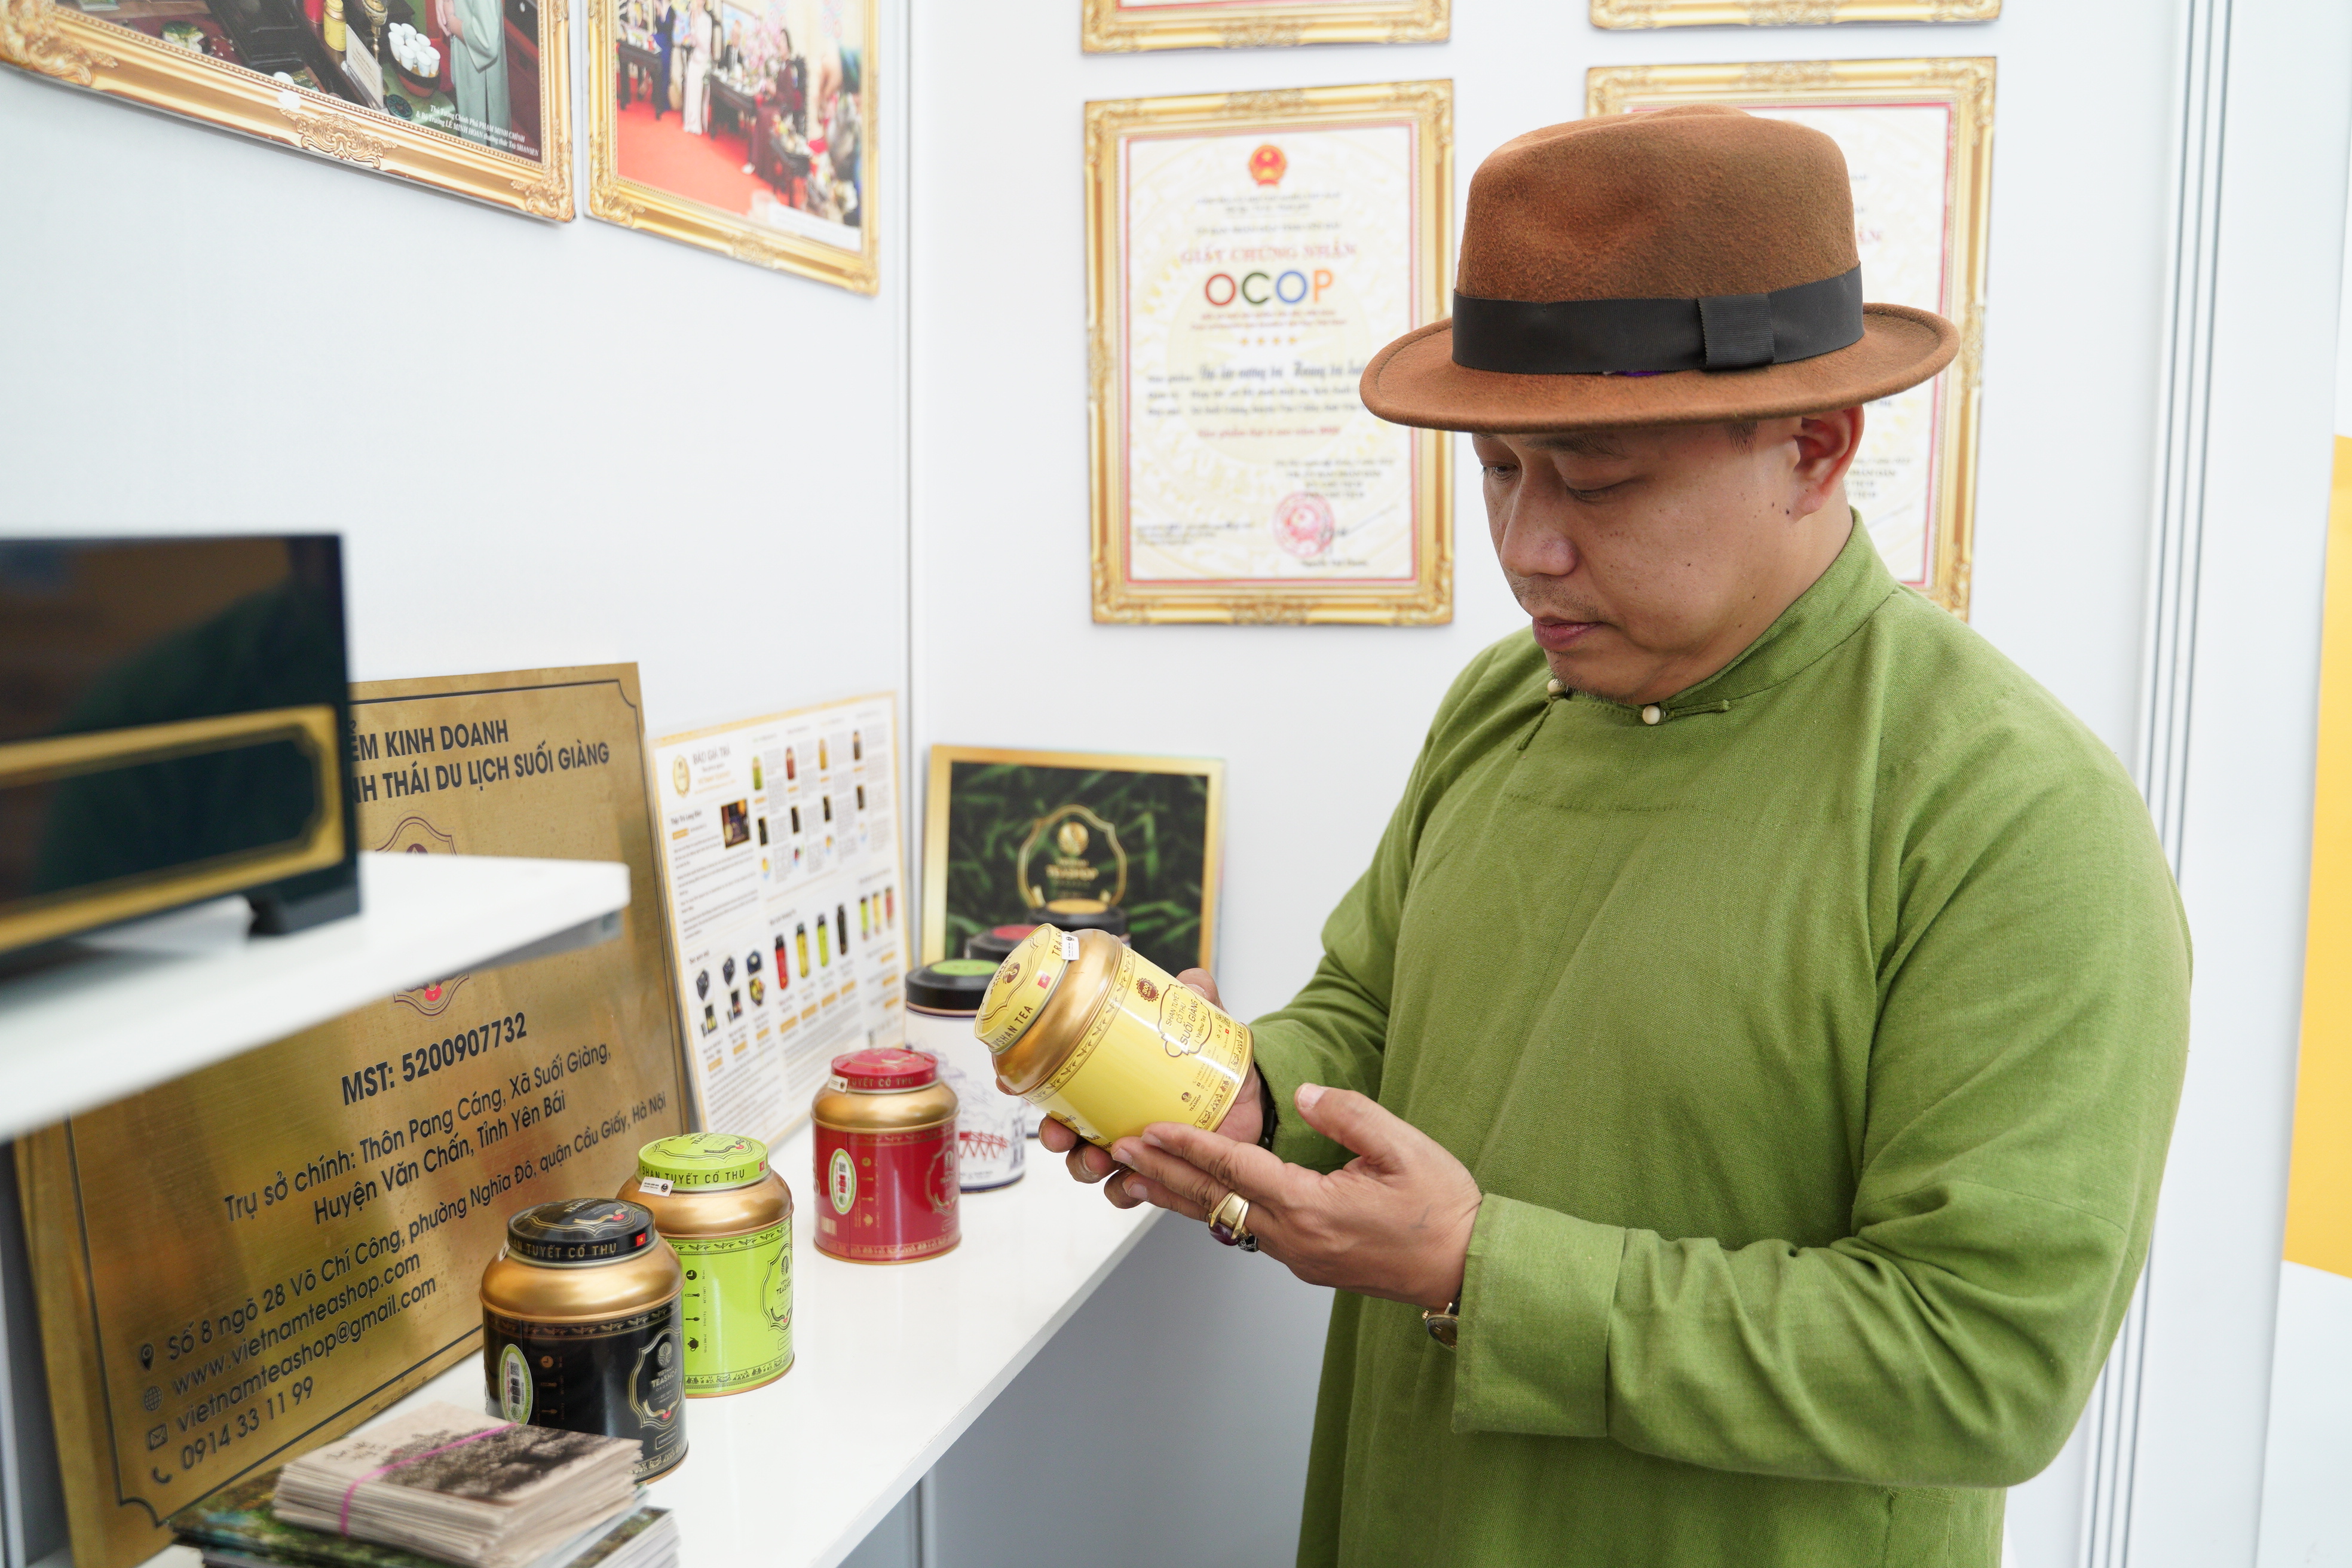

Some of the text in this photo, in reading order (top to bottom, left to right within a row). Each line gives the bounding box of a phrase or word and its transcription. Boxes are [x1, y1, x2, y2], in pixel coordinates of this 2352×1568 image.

[1205, 268, 1333, 306] OCOP
[385, 727, 435, 757] KINH
[440, 719, 509, 751] DOANH
[382, 761, 430, 798] THÁI
[436, 762, 462, 791] DU
[467, 756, 510, 791] LỊCH
[514, 740, 553, 777] SUỐI
[558, 739, 610, 770] GIÀNG
[1015, 1005, 1034, 1025] TEA
[1166, 1008, 1176, 1027] SHAN
[1180, 999, 1199, 1046] SUỐI GIÀNG
[1196, 1021, 1205, 1039] Yellow
[342, 1012, 527, 1105] MST: 5200907732
[1189, 1095, 1202, 1111] TEASHOP
[224, 1043, 611, 1222] Trụ sở chính: Thôn Pang Cáng, Xã Suối Giàng,
[314, 1090, 565, 1225] Huyện Văn Chấn, Tỉnh Yên Bái
[642, 1166, 745, 1184] SHAN TUYẾT CỔ THỤ
[169, 1091, 667, 1361] Số 8 ngõ 28 Võ Chí Công, phường Nghĩa Đô, quận Cầu Giấy, Hà Nội
[526, 1244, 561, 1258] TUYẾT
[568, 1243, 586, 1258] CỔ
[592, 1243, 617, 1255] THỤ
[173, 1253, 420, 1396] www.vietnamteashop.com
[178, 1277, 436, 1432] vietnamteashop@gmail.com
[651, 1368, 678, 1388] TEASHOP
[182, 1376, 314, 1471] 0914 33 11 99
